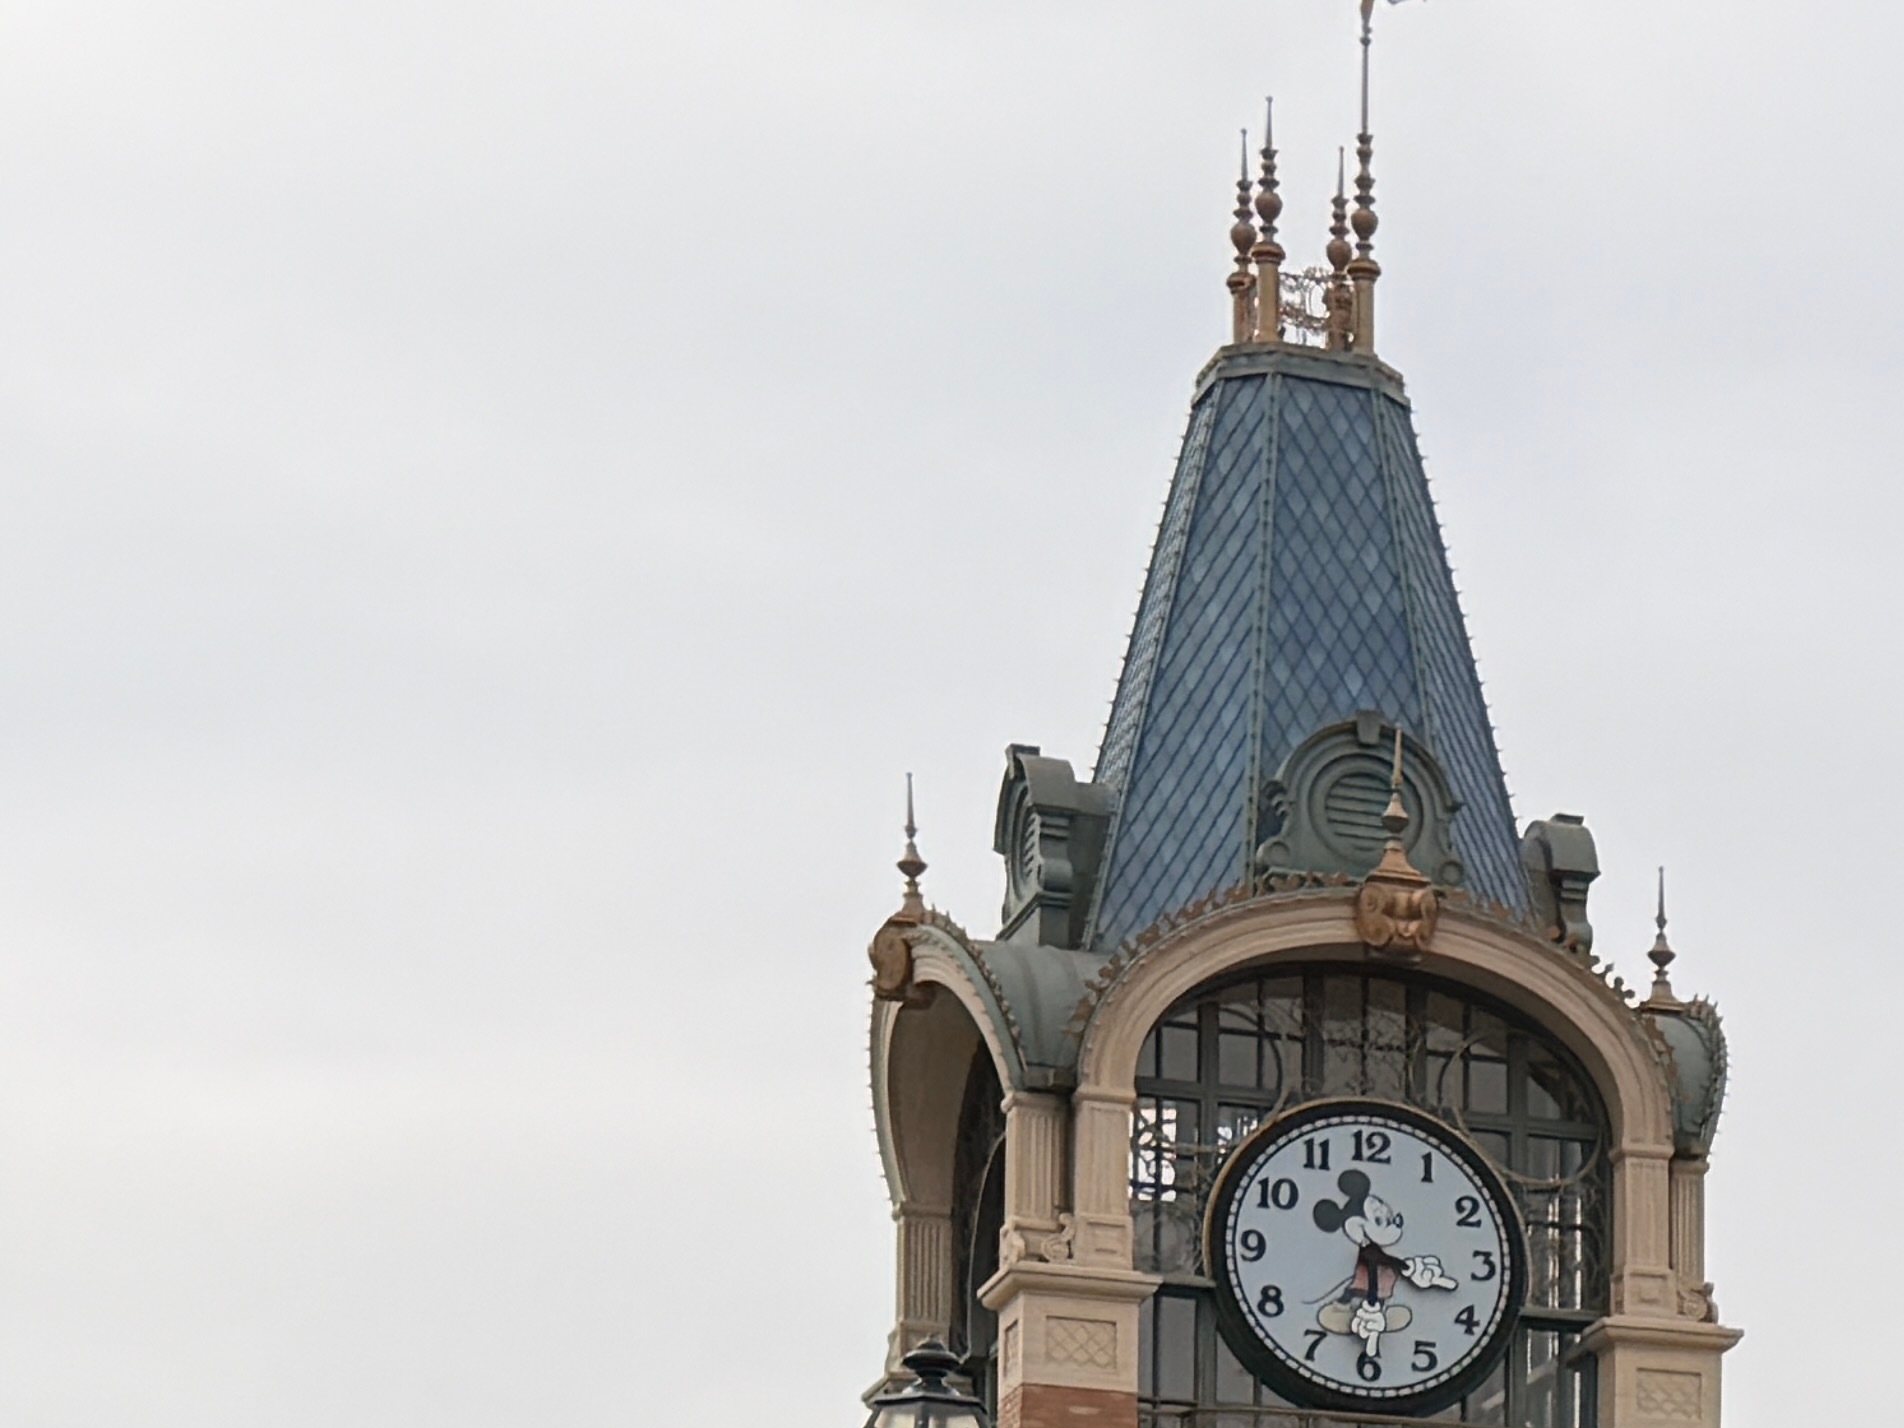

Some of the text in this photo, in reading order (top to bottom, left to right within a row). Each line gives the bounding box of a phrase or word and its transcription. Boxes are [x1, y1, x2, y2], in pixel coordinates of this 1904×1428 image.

[1303, 1138, 1330, 1170] 11
[1352, 1130, 1391, 1164] 12
[1421, 1152, 1434, 1183] 1
[1257, 1177, 1299, 1210] 10
[1455, 1195, 1482, 1228] 2
[1240, 1229, 1267, 1262] 9
[1470, 1251, 1496, 1281] 3
[1257, 1285, 1284, 1317] 8
[1455, 1305, 1481, 1335] 4
[1304, 1329, 1327, 1362] 7
[1411, 1341, 1438, 1372] 5
[1356, 1346, 1382, 1382] 6
